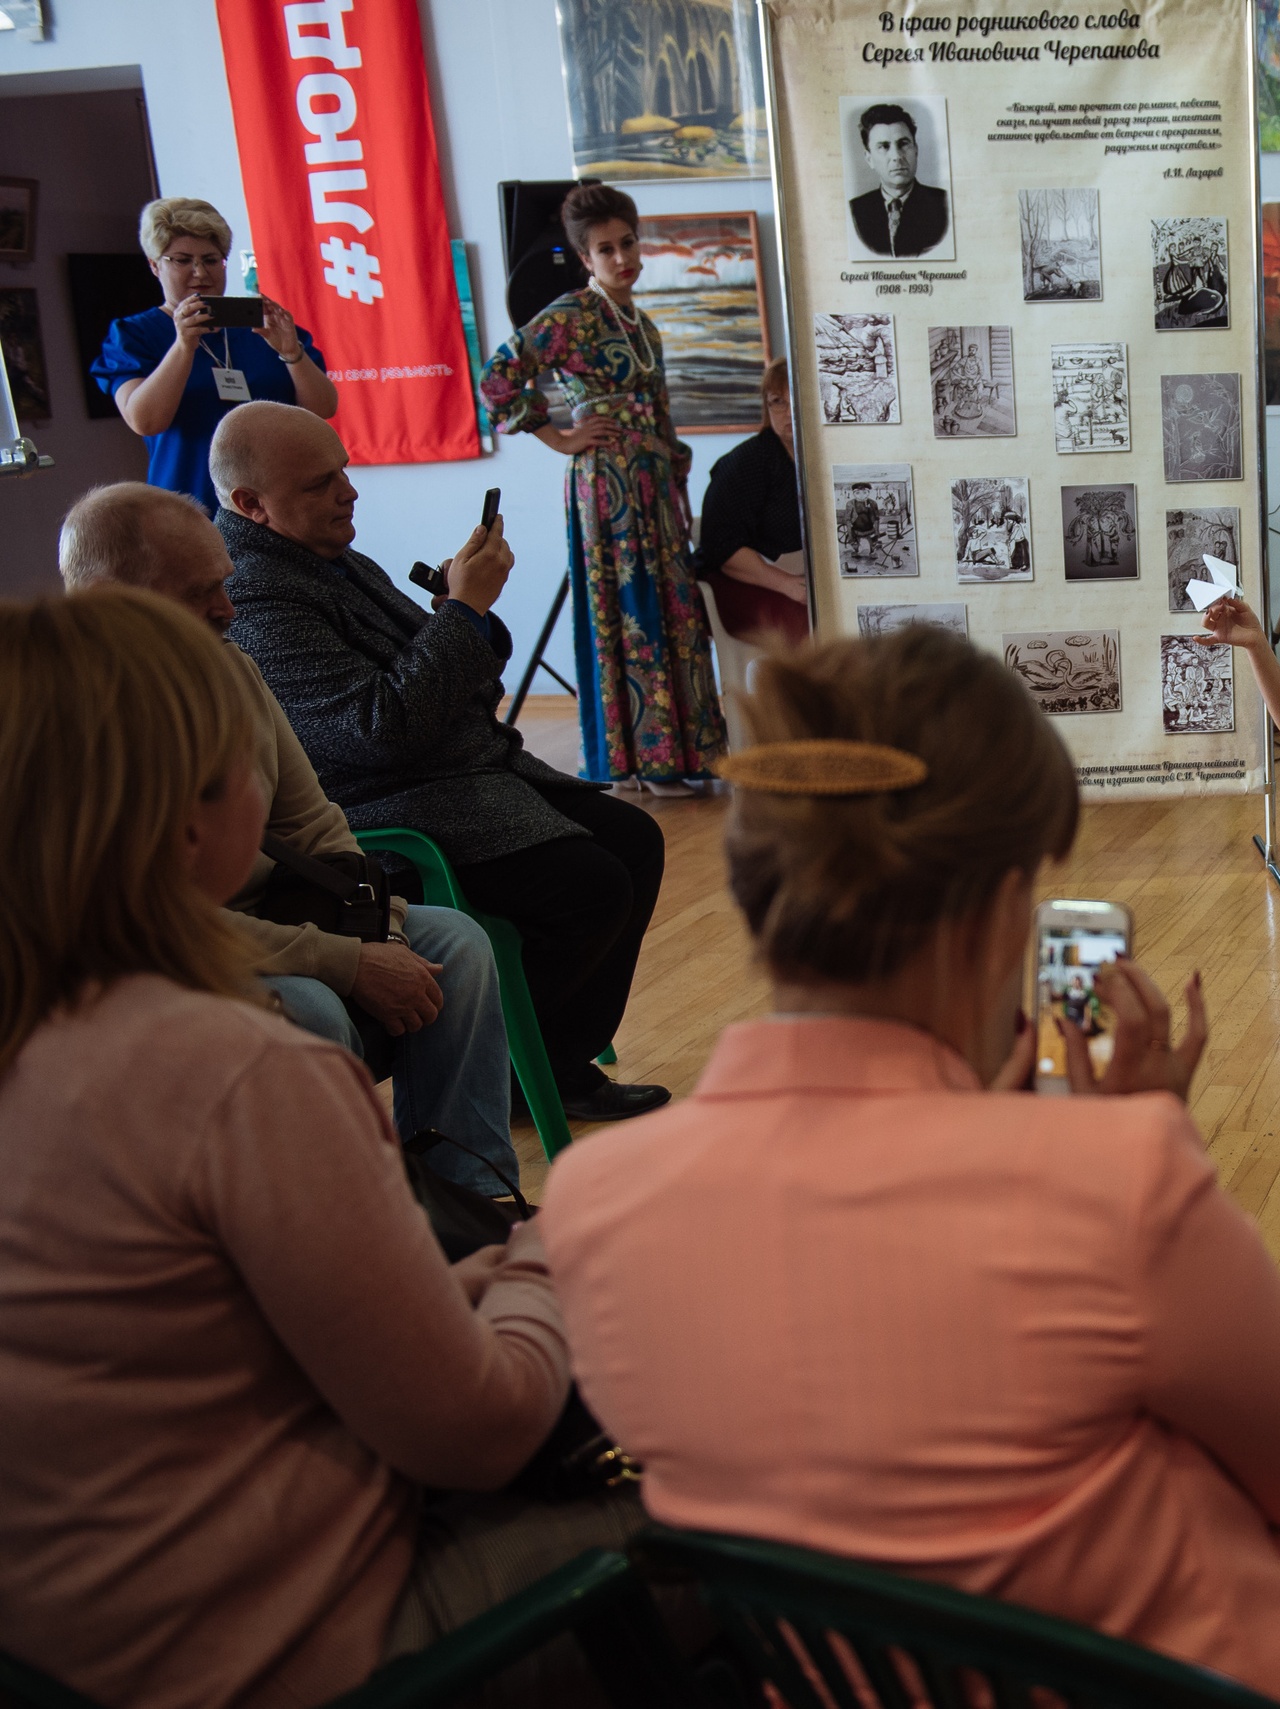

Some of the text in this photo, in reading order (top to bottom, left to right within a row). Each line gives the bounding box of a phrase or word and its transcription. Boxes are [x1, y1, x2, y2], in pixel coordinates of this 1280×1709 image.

[879, 9, 1141, 36] В краю родникового слова
[862, 38, 1160, 68] Сергея Ивановича Черепанова
[840, 269, 967, 284] Сергей Иванович Черепанов
[380, 364, 453, 383] реальность
[1077, 777, 1104, 788] овому
